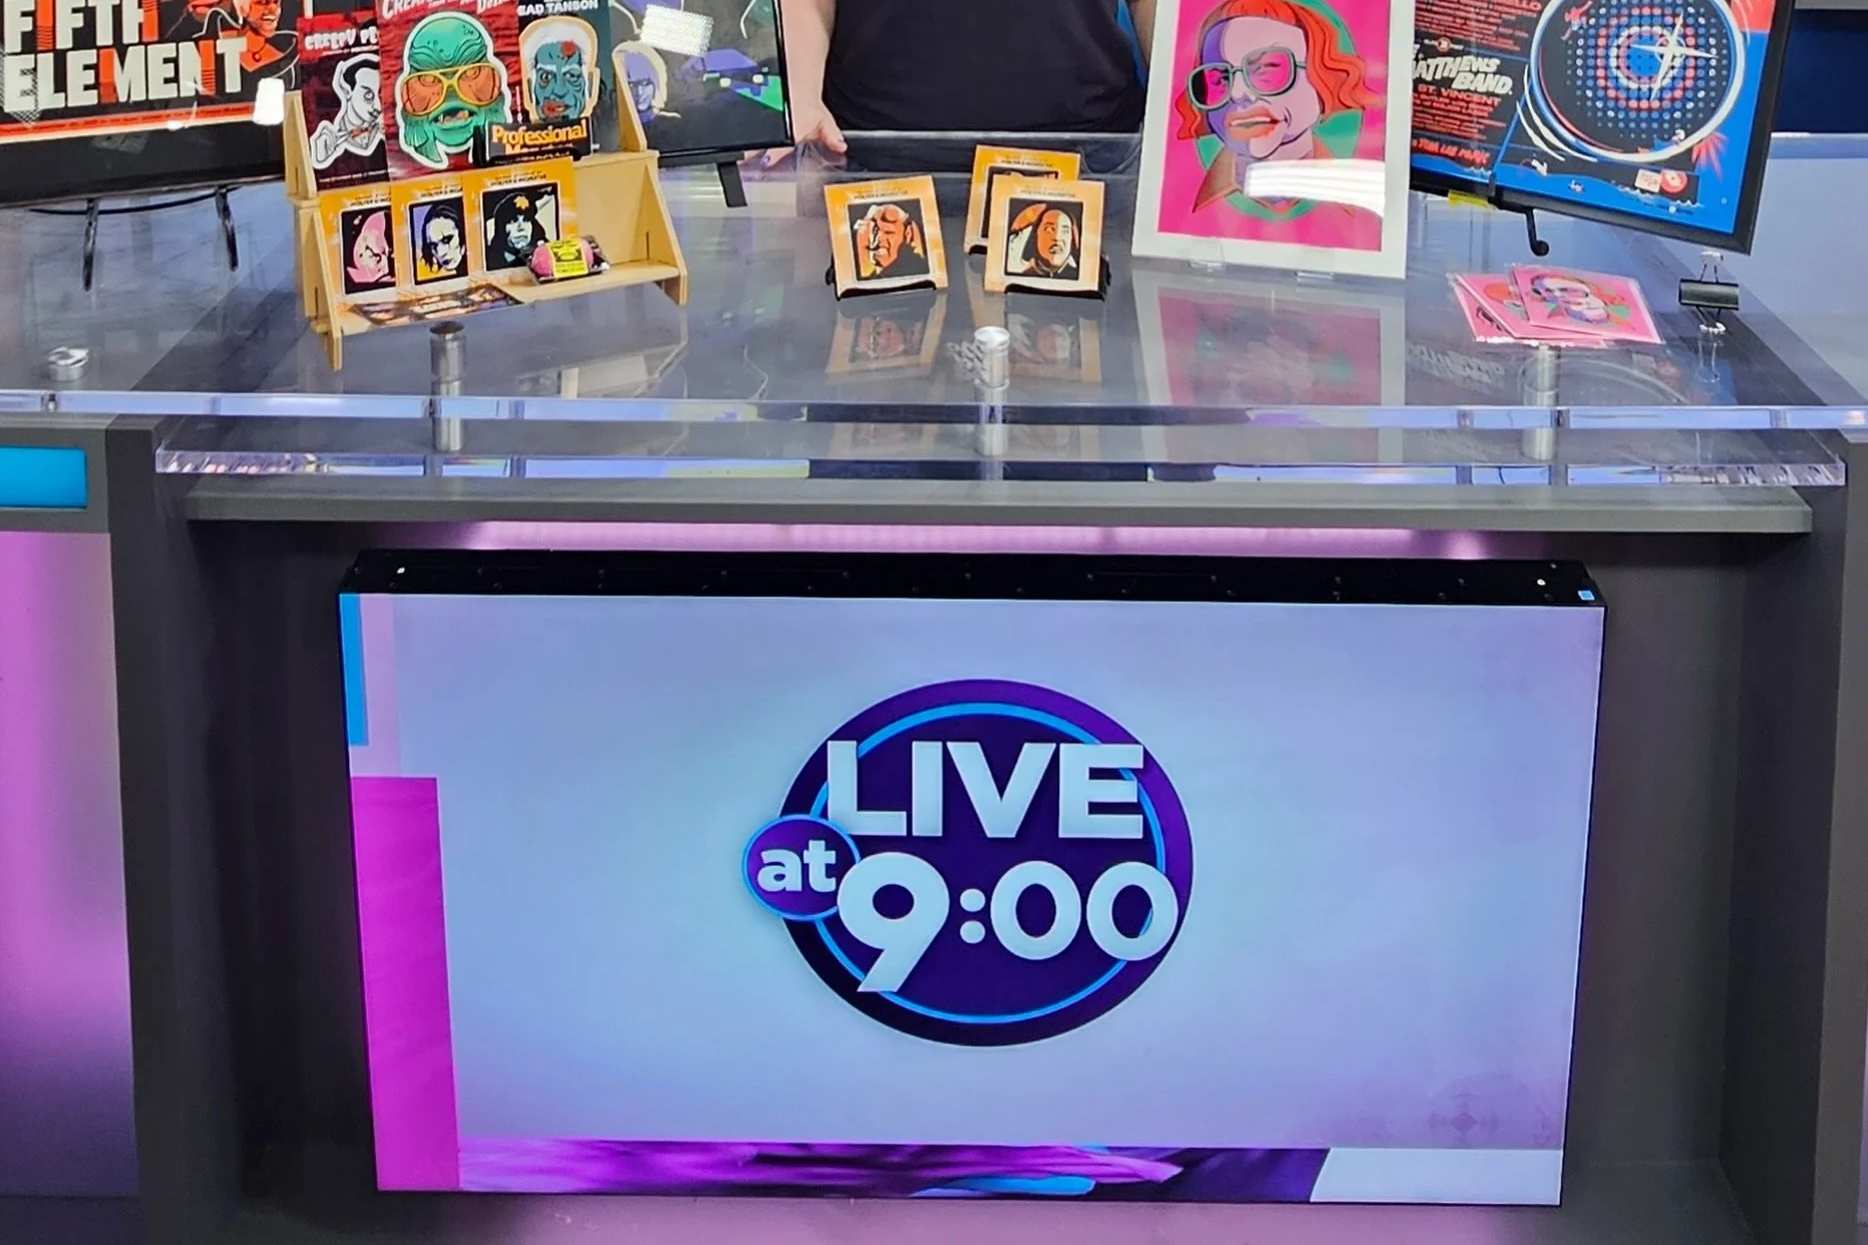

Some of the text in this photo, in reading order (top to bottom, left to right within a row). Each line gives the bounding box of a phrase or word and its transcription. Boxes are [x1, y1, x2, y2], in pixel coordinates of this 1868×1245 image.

[360, 26, 379, 44] PE
[517, 3, 544, 16] EAD
[3, 37, 249, 113] ELEMENT
[491, 119, 588, 146] Professional
[827, 739, 1144, 839] LIVE
[756, 839, 1179, 993] at 9:00
